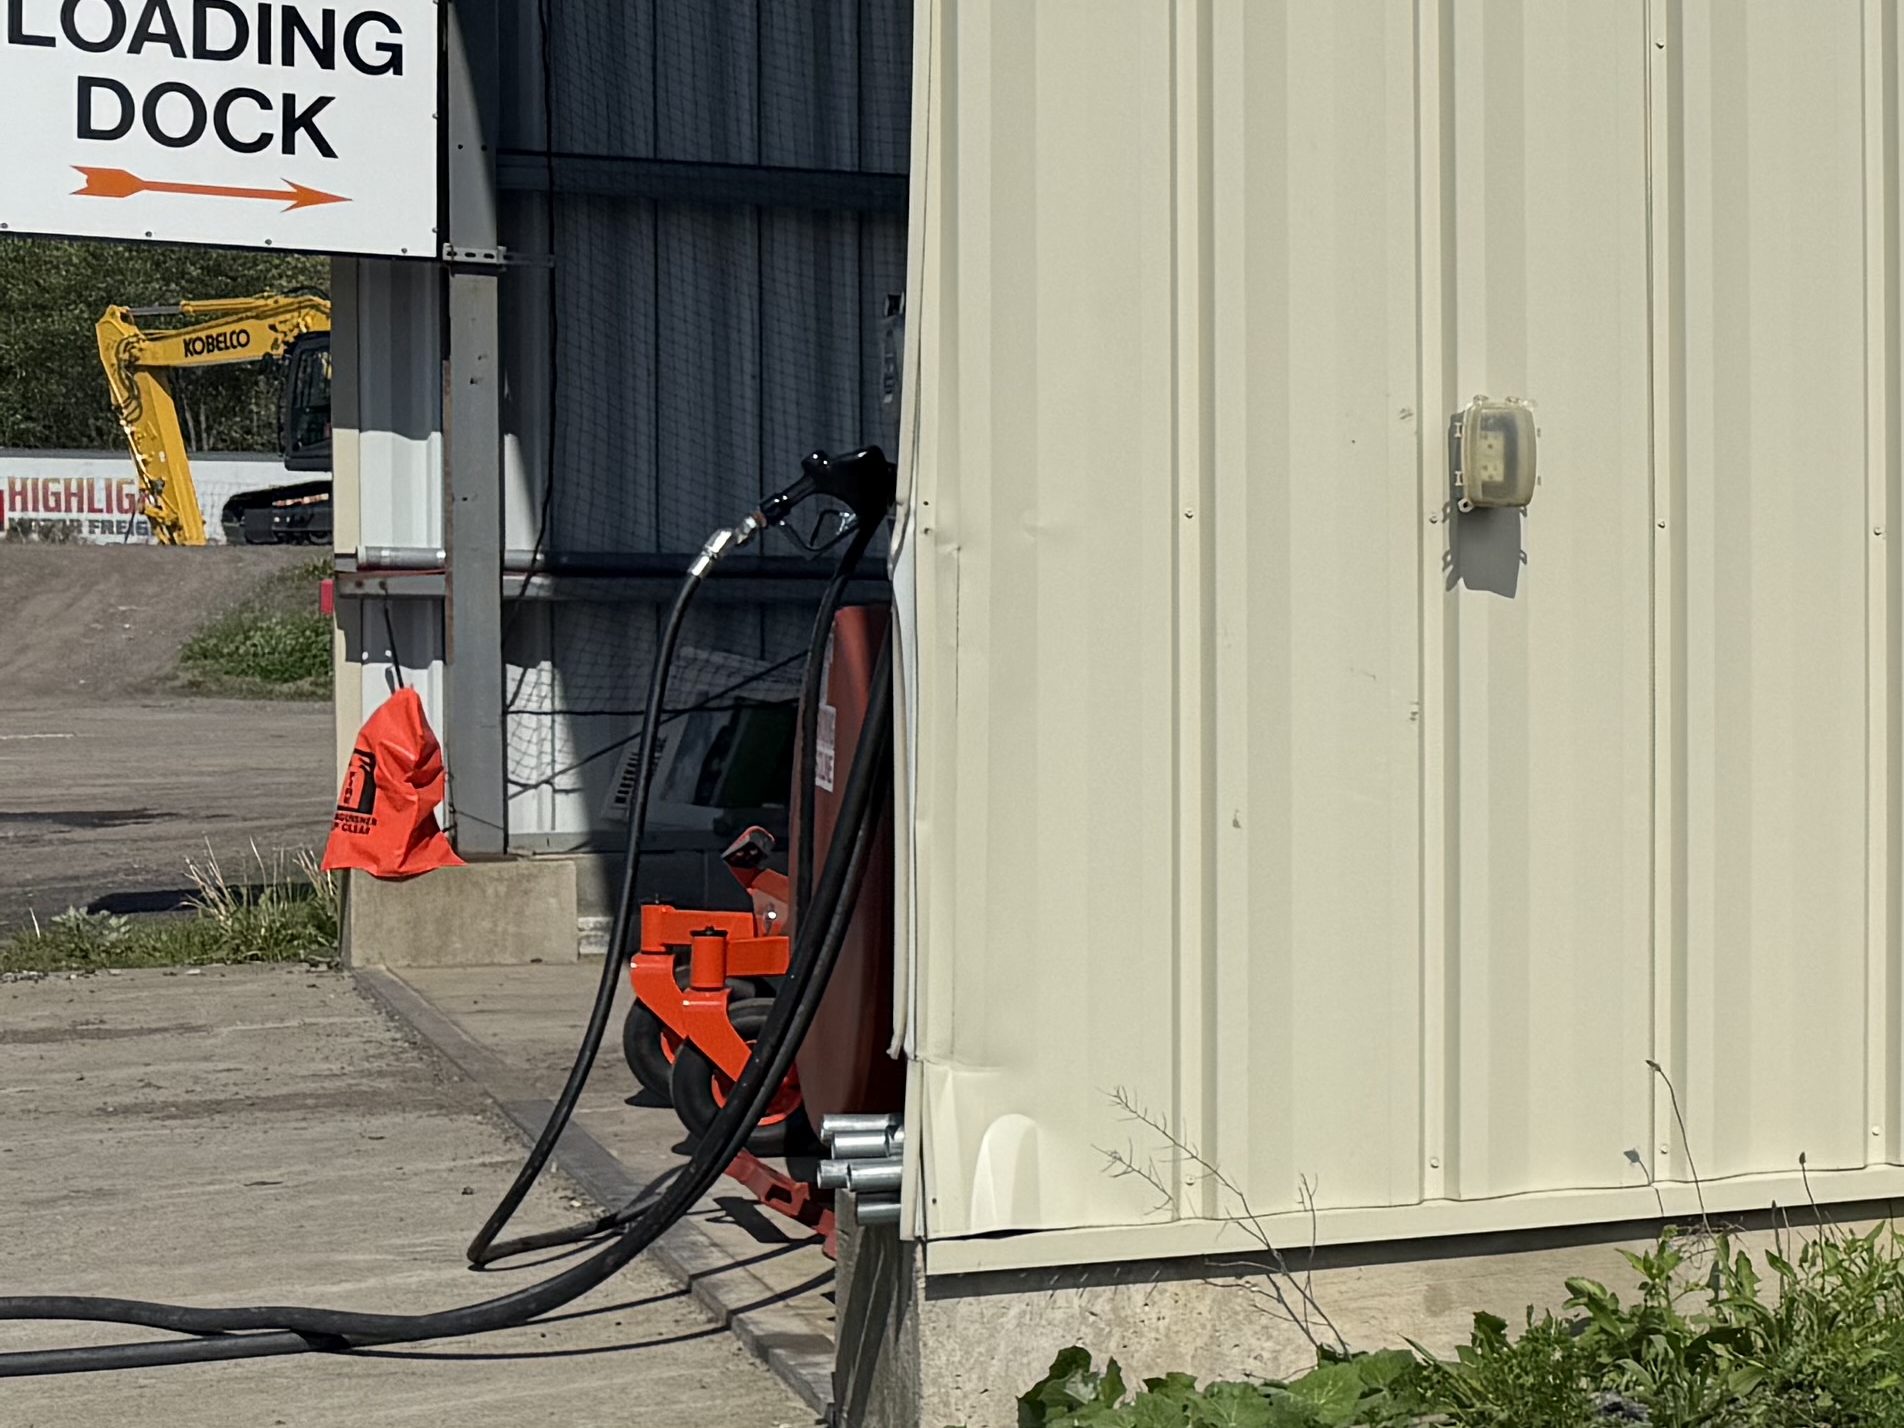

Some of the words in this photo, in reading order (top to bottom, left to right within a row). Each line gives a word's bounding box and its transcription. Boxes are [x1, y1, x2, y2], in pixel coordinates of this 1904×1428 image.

[77, 75, 339, 159] DOCK
[183, 329, 251, 358] KOBELCO
[8, 476, 137, 514] HIGHLIG
